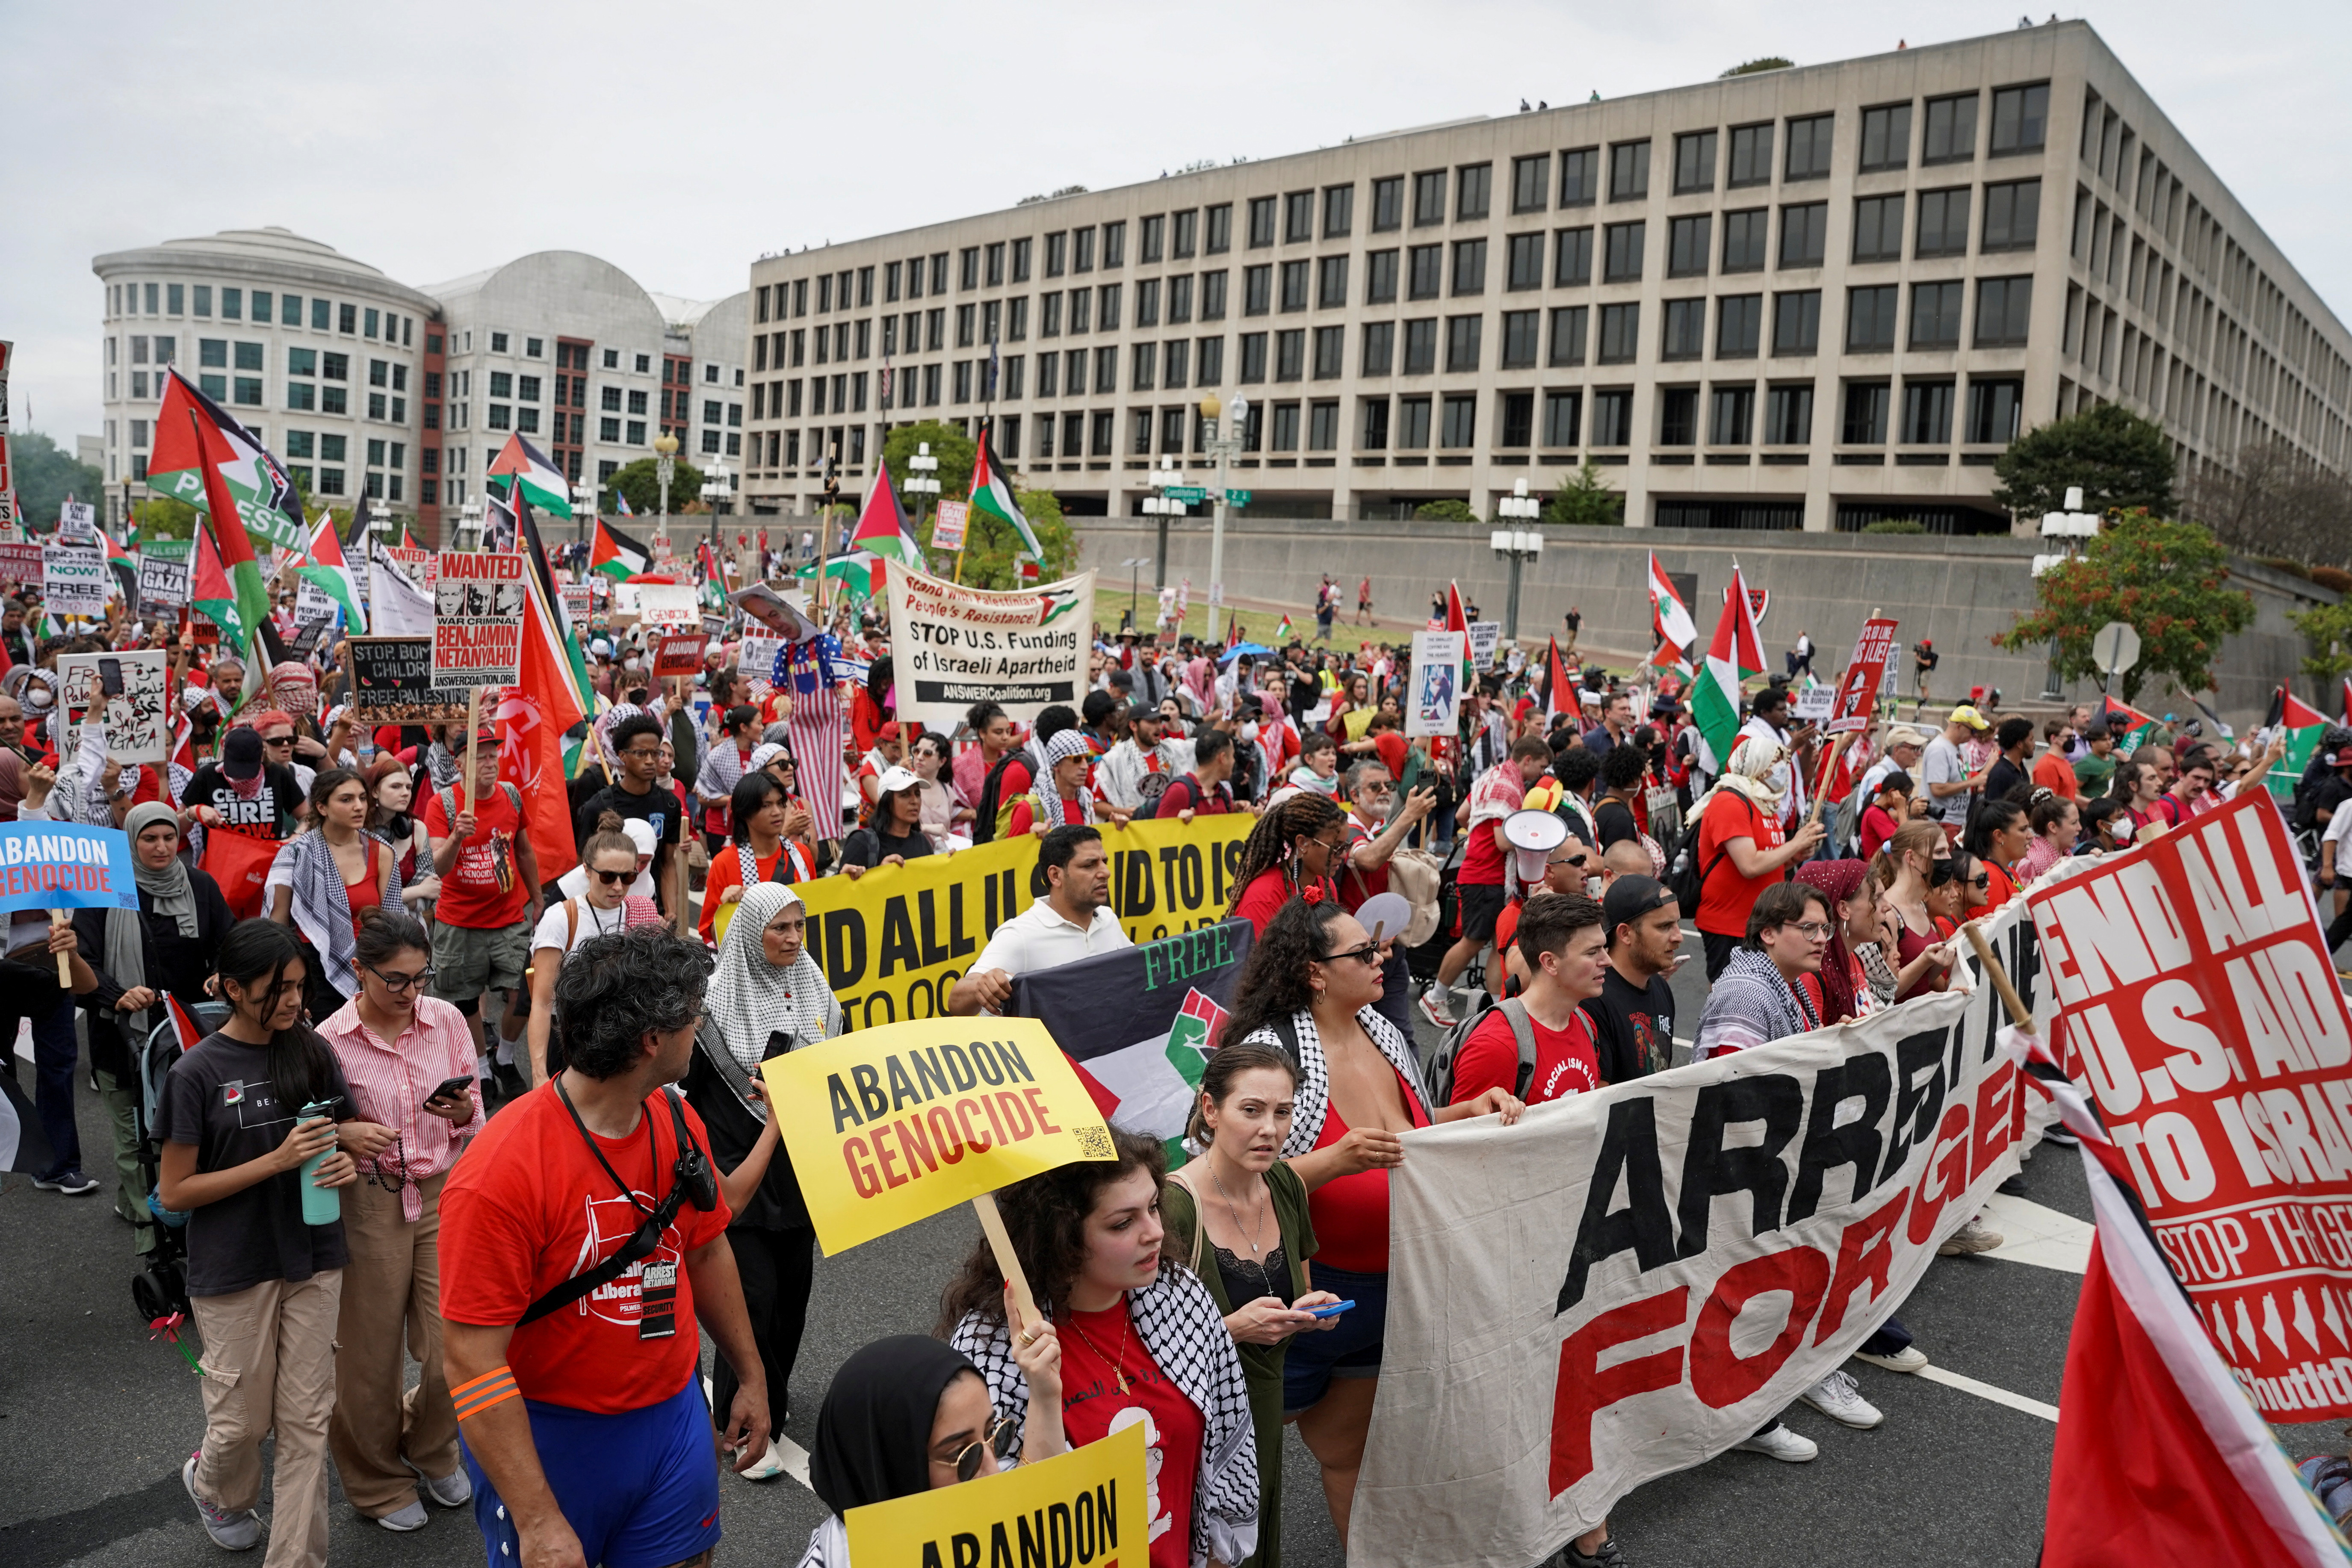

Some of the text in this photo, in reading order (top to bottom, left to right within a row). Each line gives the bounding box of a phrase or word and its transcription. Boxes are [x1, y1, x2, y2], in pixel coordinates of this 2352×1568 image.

[50, 565, 99, 576] NOW!
[144, 560, 187, 577] STOP THE
[442, 553, 523, 579] WANTED
[46, 582, 102, 594] FREE
[142, 572, 184, 593] GAZA
[141, 588, 184, 602] GENOCIDE
[906, 576, 1037, 608] Stand with Palestinian
[298, 606, 320, 615] PEOPLE
[649, 609, 692, 623] GENOCIDE
[905, 594, 1039, 625] People's Resistance!
[437, 626, 518, 647] BENJAMIN
[910, 621, 1077, 650] STOP U.S. Funding
[399, 644, 431, 660] BOM
[435, 647, 516, 668] NETANYAHU
[664, 641, 700, 656] ABANDON
[372, 661, 431, 678] CHILDR
[661, 655, 696, 669] GENOCIDE
[913, 651, 1076, 679] of Israeli Apartheid
[434, 674, 516, 687] ANSWERCOALITION.ORG
[358, 688, 470, 706] FREE PALESTINE
[943, 685, 1052, 702] ANSWERCoalition.org
[109, 728, 160, 751] GAZA
[212, 786, 274, 803] CEE
[222, 823, 275, 839] OW.
[460, 851, 491, 861] LONGER BE
[465, 845, 479, 854] WILL
[481, 843, 490, 852] NO
[457, 868, 493, 878] IN GENOCIDE
[463, 860, 493, 870] COMPLICIT
[879, 882, 975, 978] ALL
[1105, 850, 1156, 920] ID
[1159, 843, 1204, 914] TO
[2031, 859, 2193, 1007] END
[2175, 804, 2311, 955] ALL
[1138, 924, 1235, 992] FREE
[2067, 978, 2247, 1116] U.S.
[2224, 939, 2352, 1079] AID
[1544, 1057, 1582, 1098] SOCIALISM
[1583, 1064, 1591, 1076] &
[827, 1041, 1036, 1134] ABANDON
[843, 1087, 1063, 1199] GENOCIDE
[2109, 1111, 2216, 1209] TO
[2156, 1217, 2249, 1283] STOP
[2249, 1205, 2328, 1267] THE
[644, 1265, 676, 1280] ARREST
[592, 1282, 642, 1301] Libera
[643, 1277, 676, 1288] NETANYAHU
[643, 1301, 675, 1316] SECURITY
[1550, 1186, 1910, 1502] FOR
[1063, 1379, 1106, 1413] النصر
